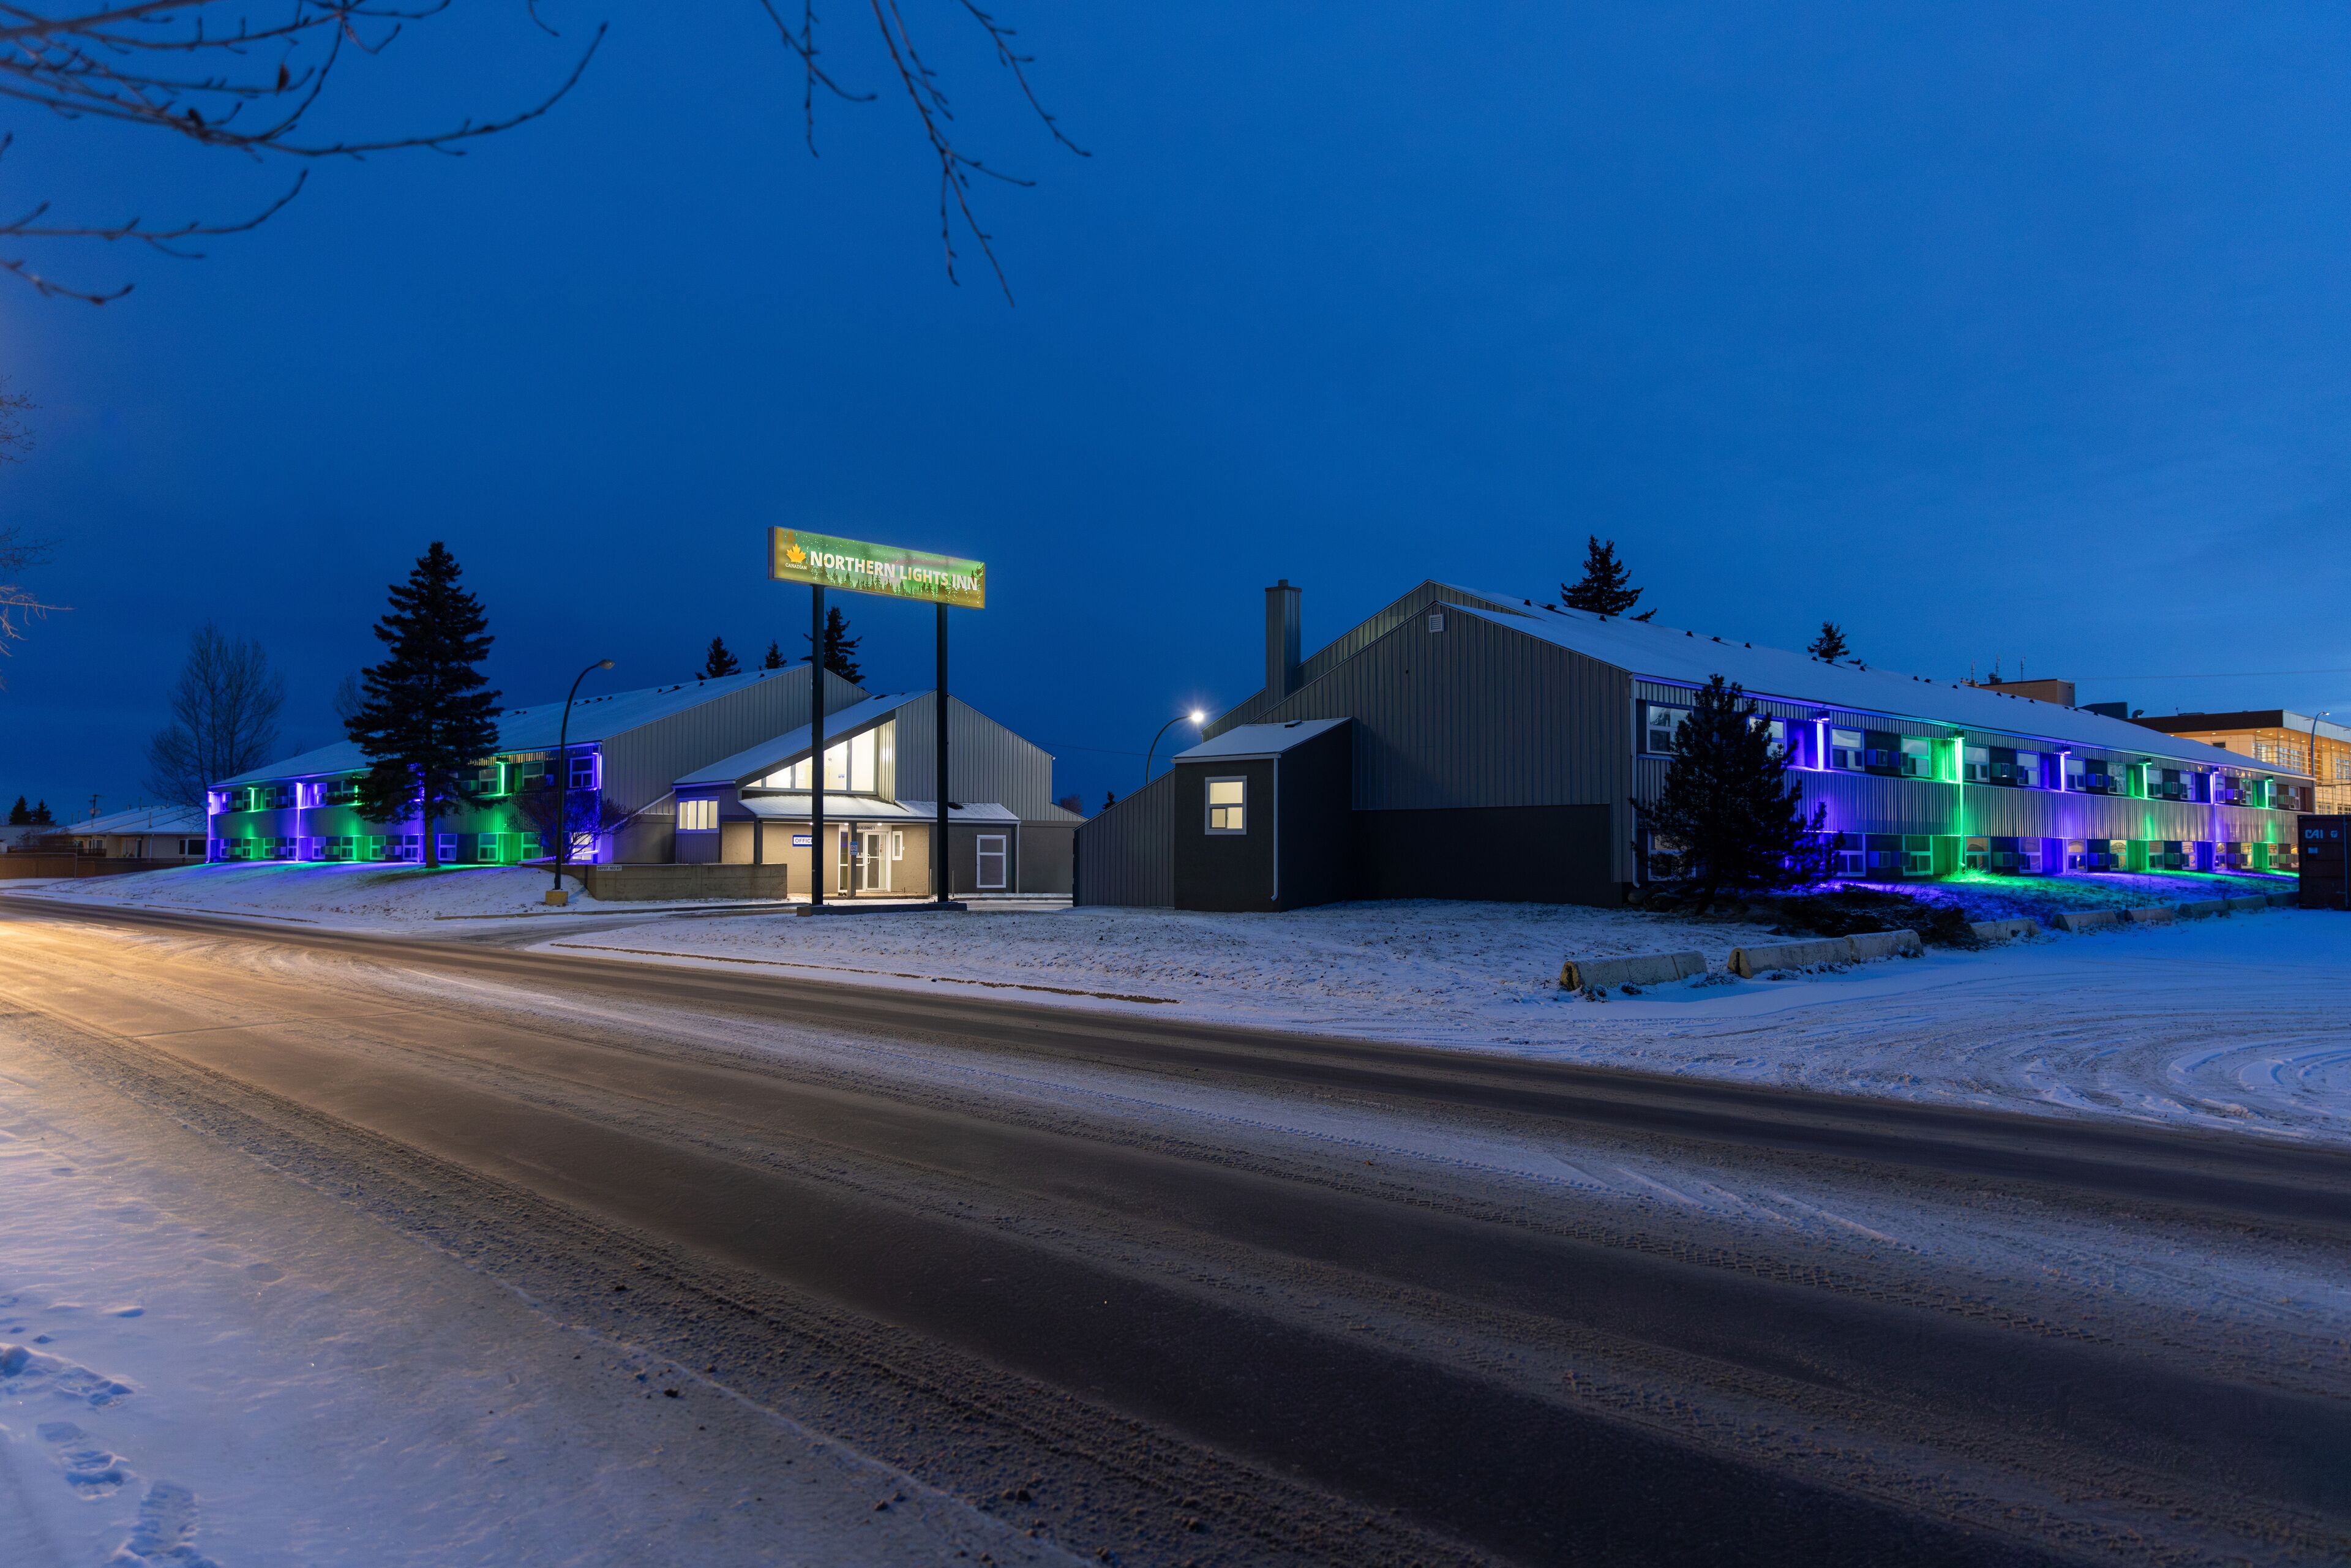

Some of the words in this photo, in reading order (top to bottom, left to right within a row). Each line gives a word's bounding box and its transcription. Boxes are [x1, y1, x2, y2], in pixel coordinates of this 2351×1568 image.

[810, 551, 895, 578] NORTHERN
[899, 566, 948, 586] LIGHTS
[952, 574, 977, 591] INN
[2304, 829, 2323, 839] CAI
